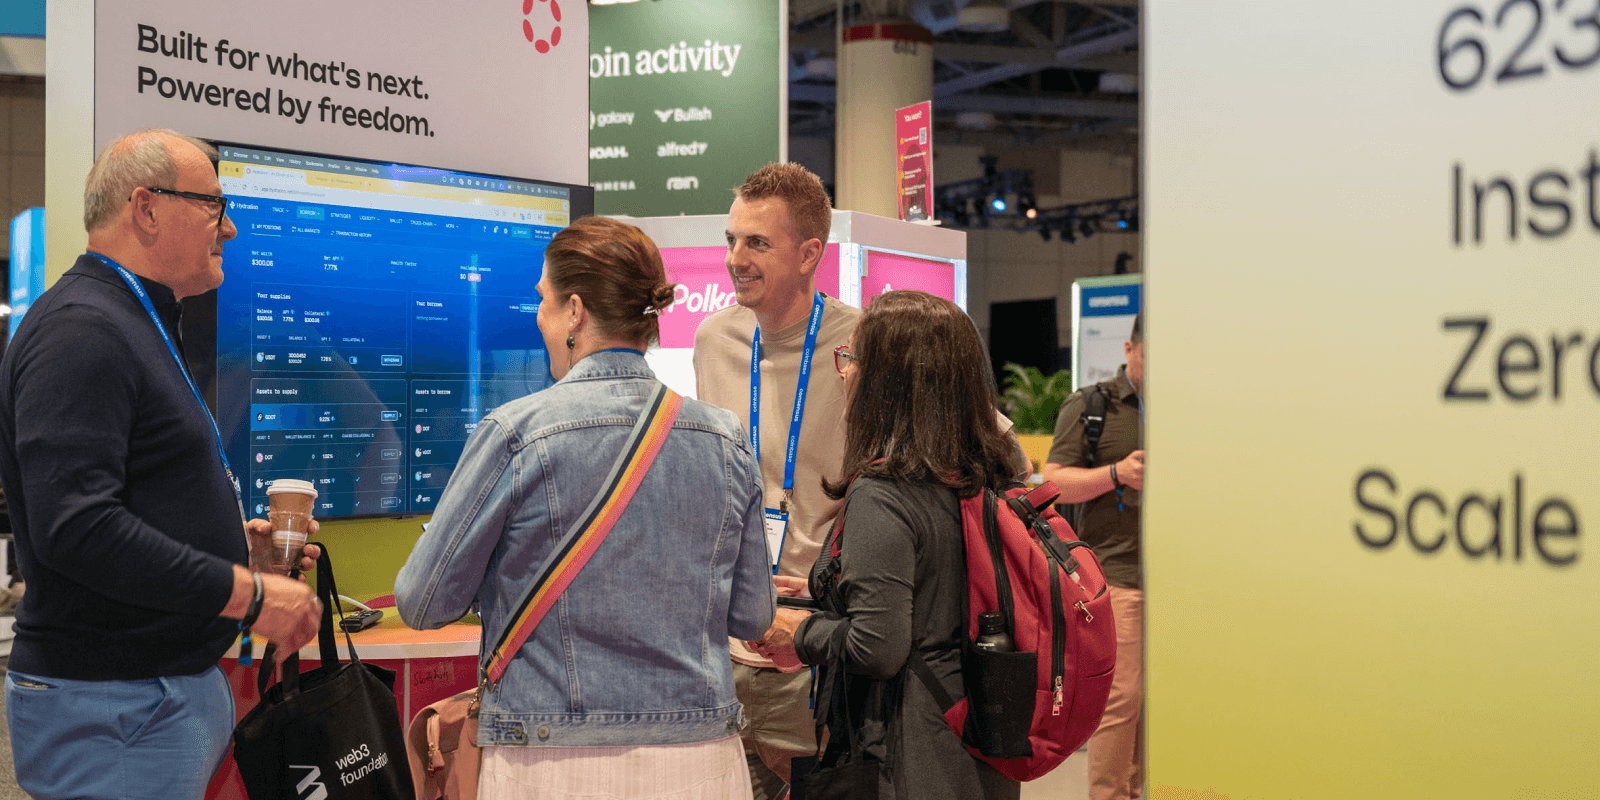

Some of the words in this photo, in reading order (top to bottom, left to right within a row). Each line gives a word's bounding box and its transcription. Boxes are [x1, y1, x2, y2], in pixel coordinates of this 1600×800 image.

[137, 23, 208, 63] Built
[214, 39, 260, 72] for
[266, 52, 361, 89] what's
[367, 71, 429, 100] next.
[635, 39, 742, 77] activity
[137, 65, 271, 114] Powered
[278, 90, 312, 124] by
[318, 96, 435, 137] freedom.
[673, 107, 712, 122] Bullish
[597, 111, 635, 127] galaxy
[657, 141, 698, 157] alfred
[666, 176, 699, 190] rain
[236, 201, 260, 210] Hydration
[270, 293, 291, 301] supplies
[810, 304, 821, 336] consensus
[802, 348, 811, 375] coinbase
[1441, 315, 1600, 403] Zer
[282, 388, 298, 396] supply
[794, 388, 804, 423] consensus
[787, 435, 796, 463] coinbase
[1353, 466, 1580, 568] Scale
[335, 743, 370, 770] web3
